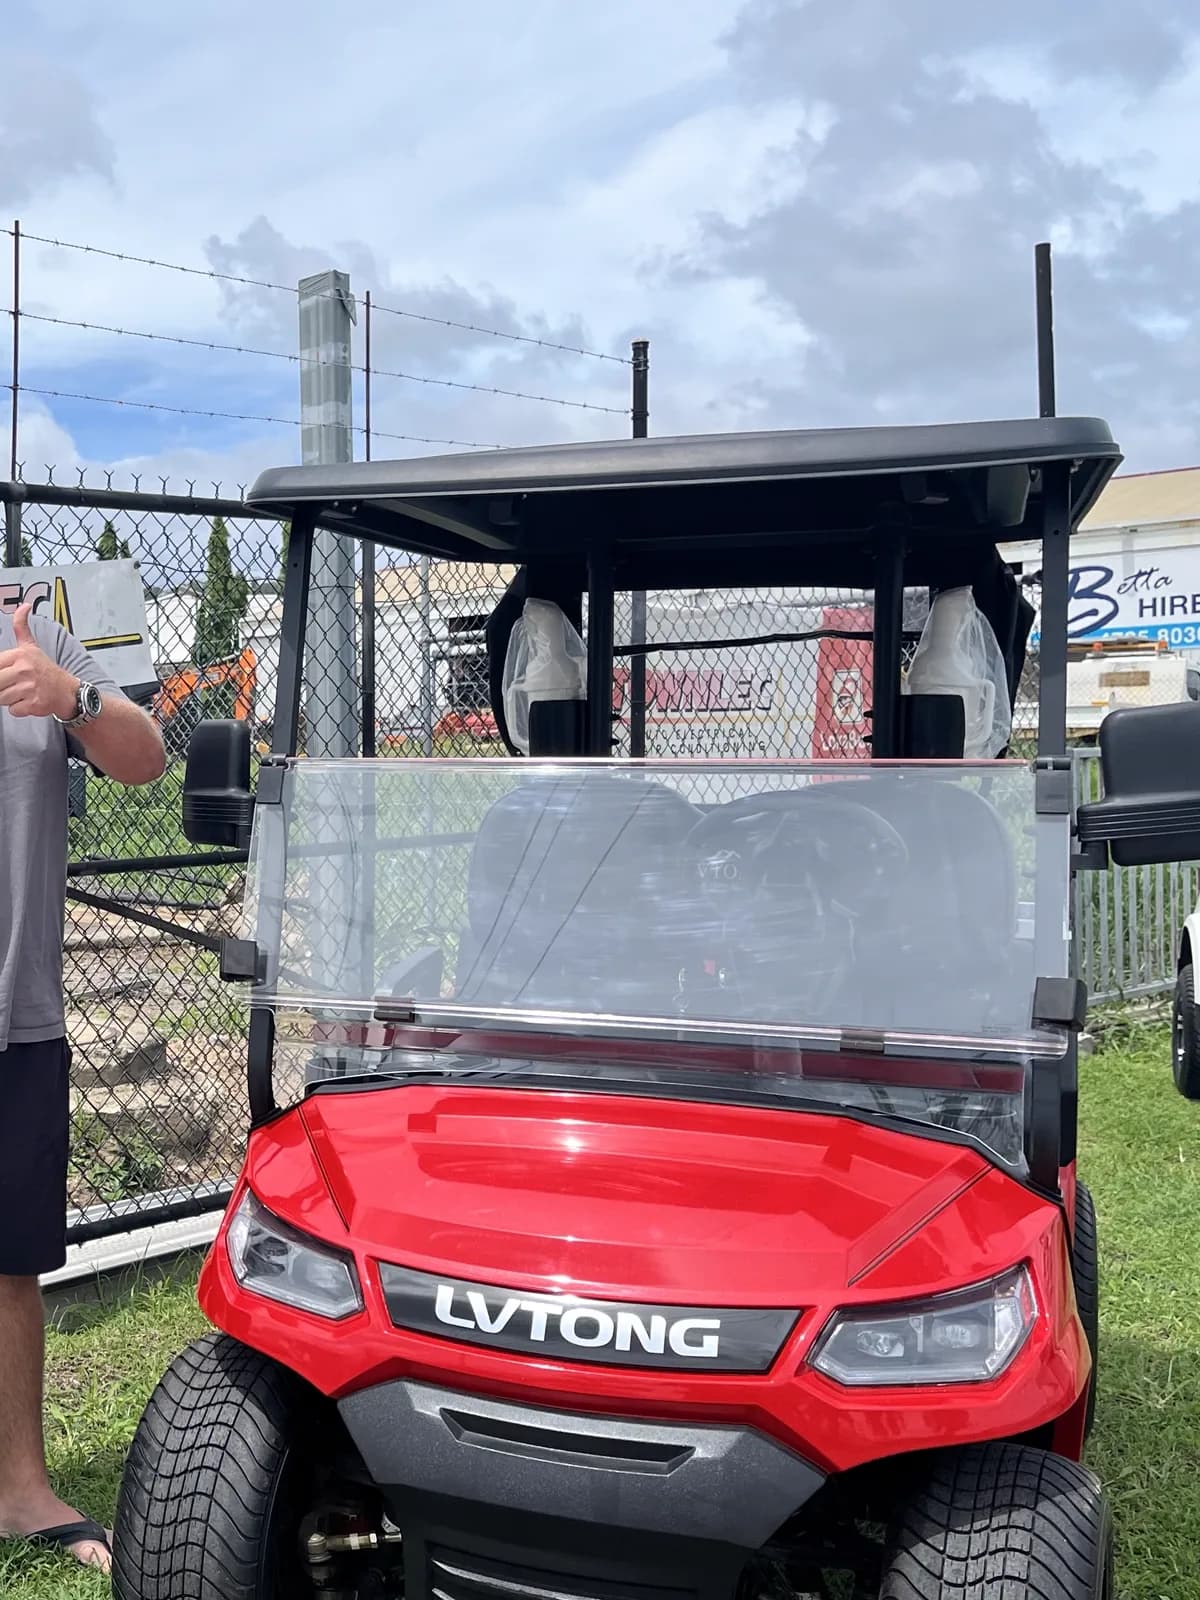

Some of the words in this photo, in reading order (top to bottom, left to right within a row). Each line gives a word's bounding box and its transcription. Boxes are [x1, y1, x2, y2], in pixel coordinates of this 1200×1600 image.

[1157, 626, 1200, 644] 803
[676, 727, 754, 740] ELECTRICAL
[671, 741, 766, 754] CONDITIONING
[434, 1284, 721, 1358] LVTONG
